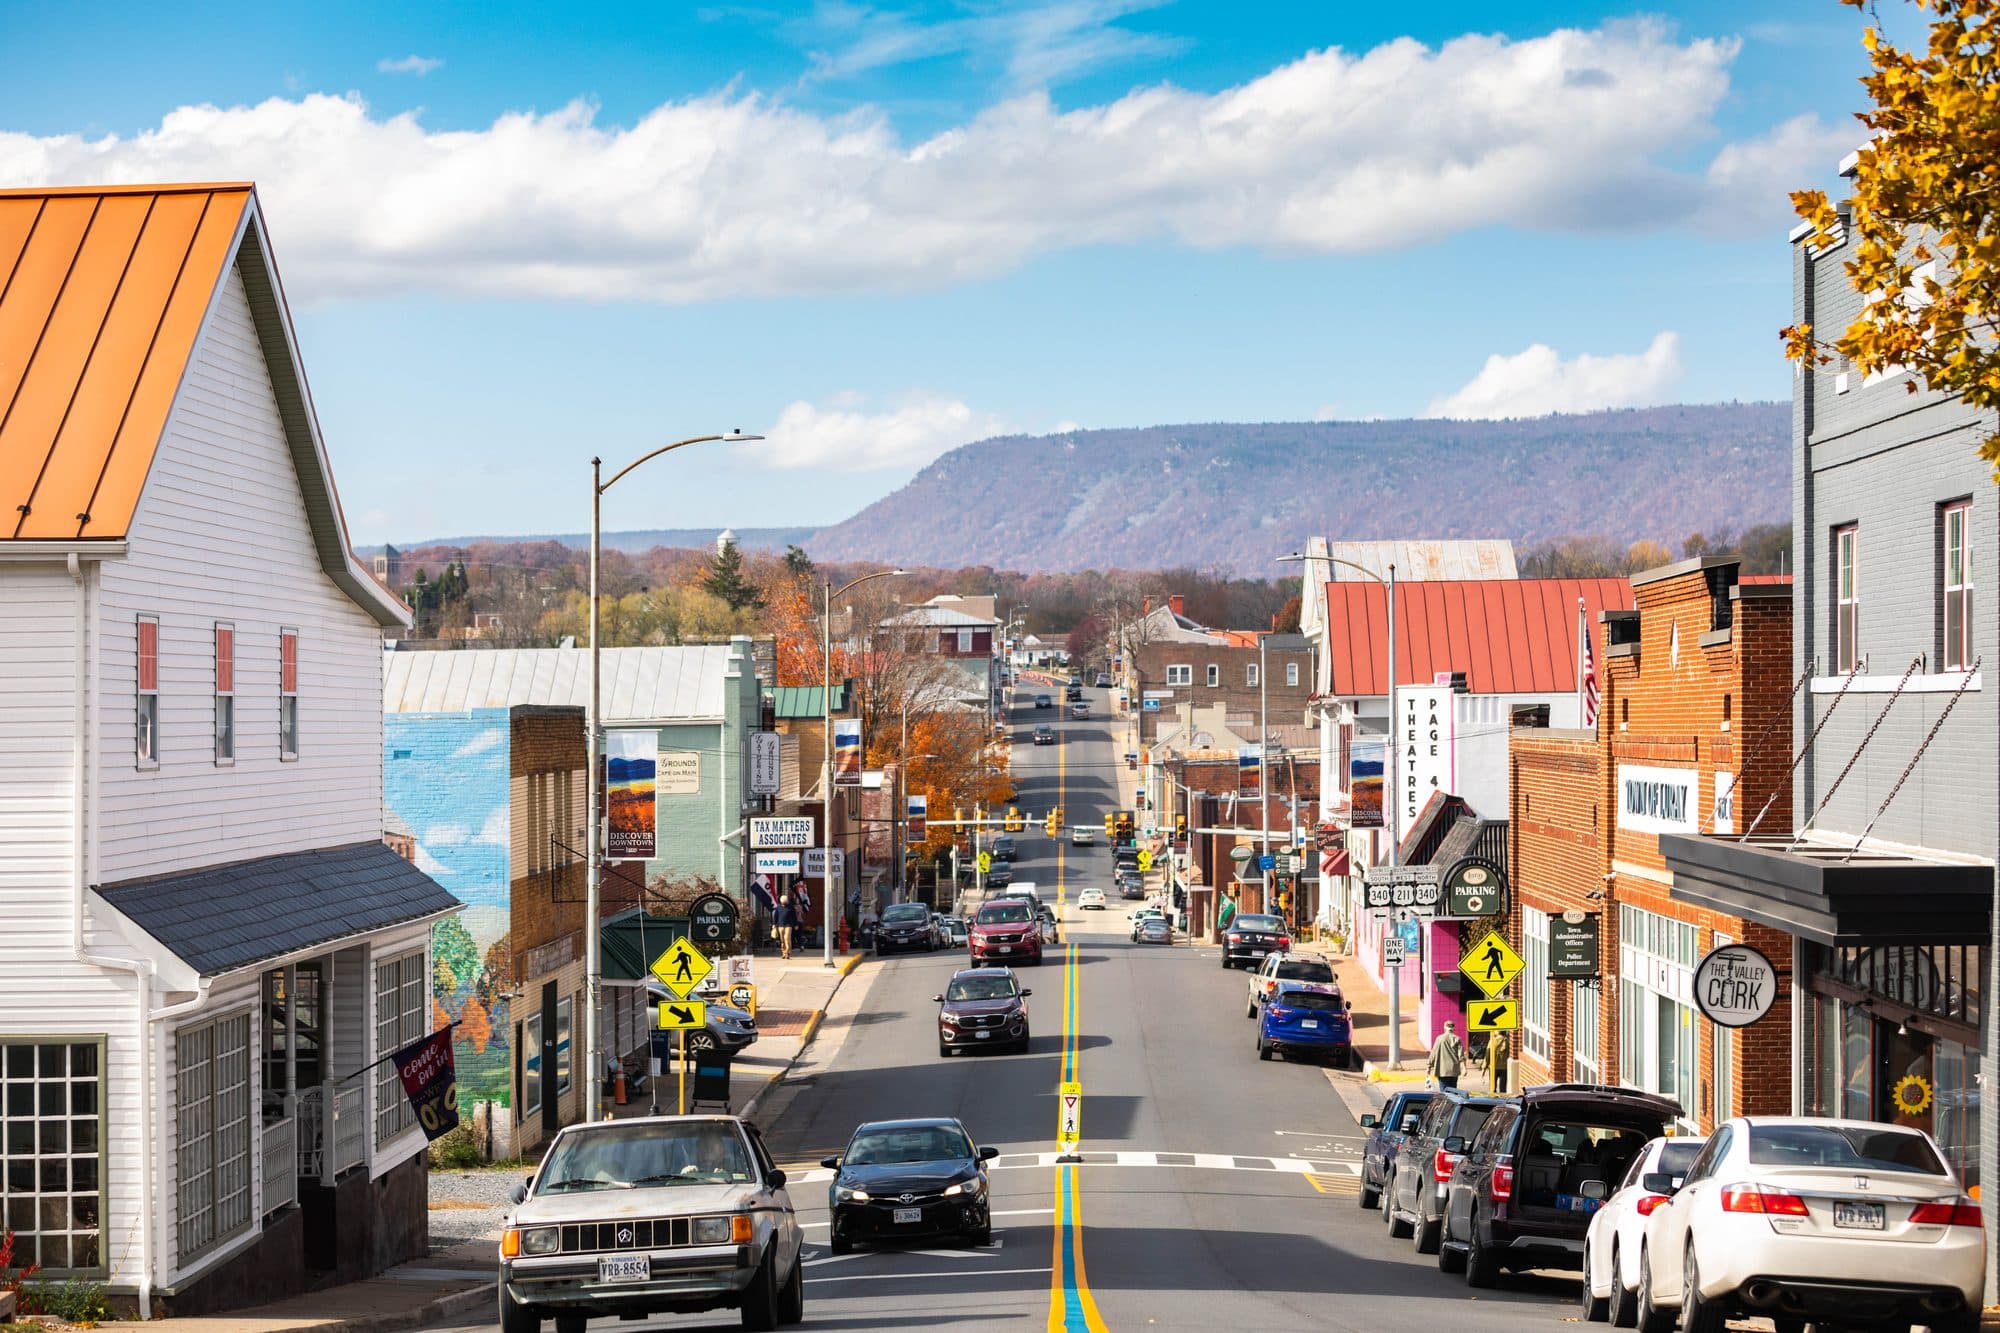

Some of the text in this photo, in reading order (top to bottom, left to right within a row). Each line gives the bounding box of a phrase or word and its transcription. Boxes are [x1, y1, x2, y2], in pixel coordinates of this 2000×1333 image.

[1429, 698, 1438, 787] PAGE 4
[1407, 698, 1417, 819] THEATRES
[1659, 783, 1689, 824] LURAY
[754, 820, 811, 833] TAX MATTERS
[610, 832, 653, 840] DISCOVER
[758, 833, 808, 845] ASSOCIATES
[776, 859, 798, 867] PREP
[1371, 890, 1388, 901] 340
[1397, 889, 1410, 900] 211
[1418, 888, 1435, 899] 340
[1455, 886, 1496, 896] PARKING
[696, 915, 730, 924] PARKING
[1385, 939, 1402, 947] ONE
[1385, 948, 1403, 956] WAY
[1558, 959, 1591, 967] Department
[1710, 962, 1766, 982] THE VALLEY
[732, 988, 753, 998] ART
[1708, 978, 1763, 1011] CORK
[403, 1044, 438, 1078] come
